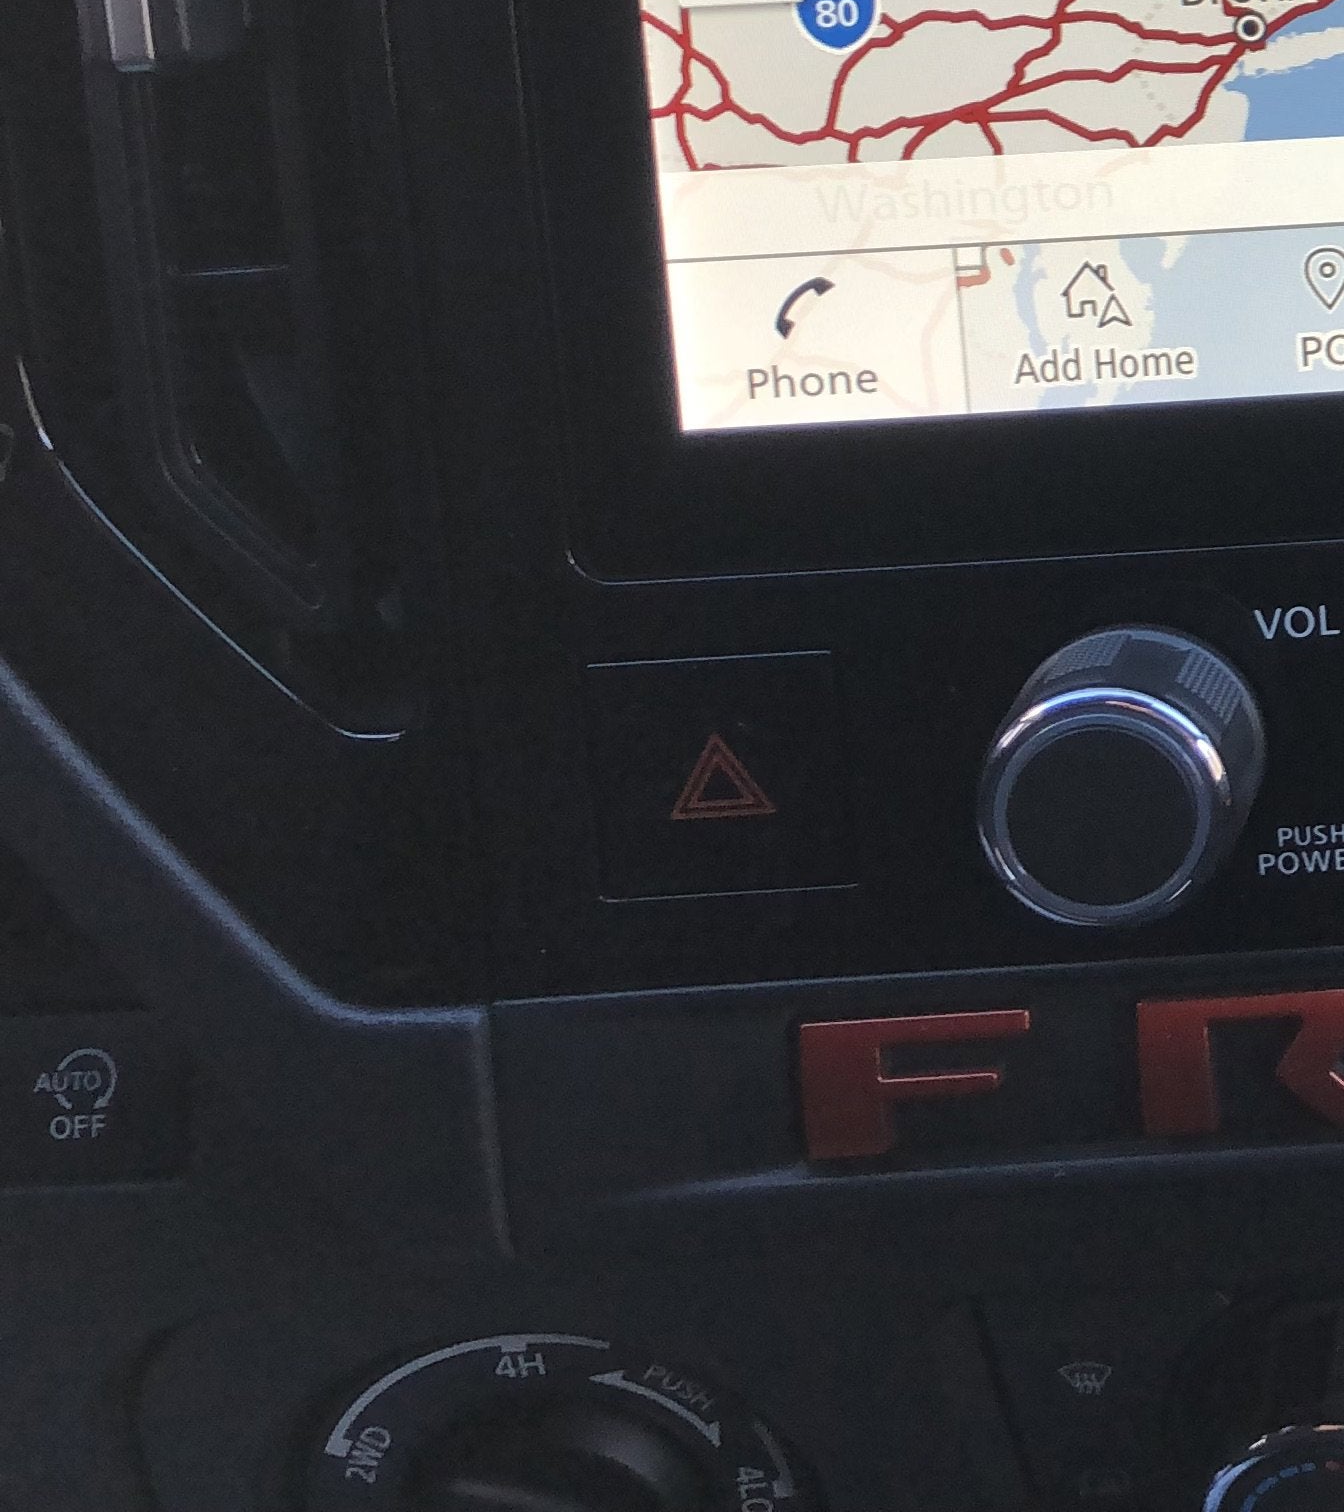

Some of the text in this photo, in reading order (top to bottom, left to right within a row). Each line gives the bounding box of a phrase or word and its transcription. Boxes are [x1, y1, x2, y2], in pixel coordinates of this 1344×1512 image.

[816, 0, 859, 29] 80
[815, 178, 1112, 225] Washington
[1015, 347, 1195, 385] Add Home
[746, 367, 880, 401] Phone
[1254, 605, 1340, 640] VOL
[33, 1071, 101, 1092] AUTO
[50, 1115, 105, 1139] OFF
[494, 1354, 546, 1378] 4H
[643, 1365, 714, 1412] PUSH
[345, 1425, 392, 1484] 2WD
